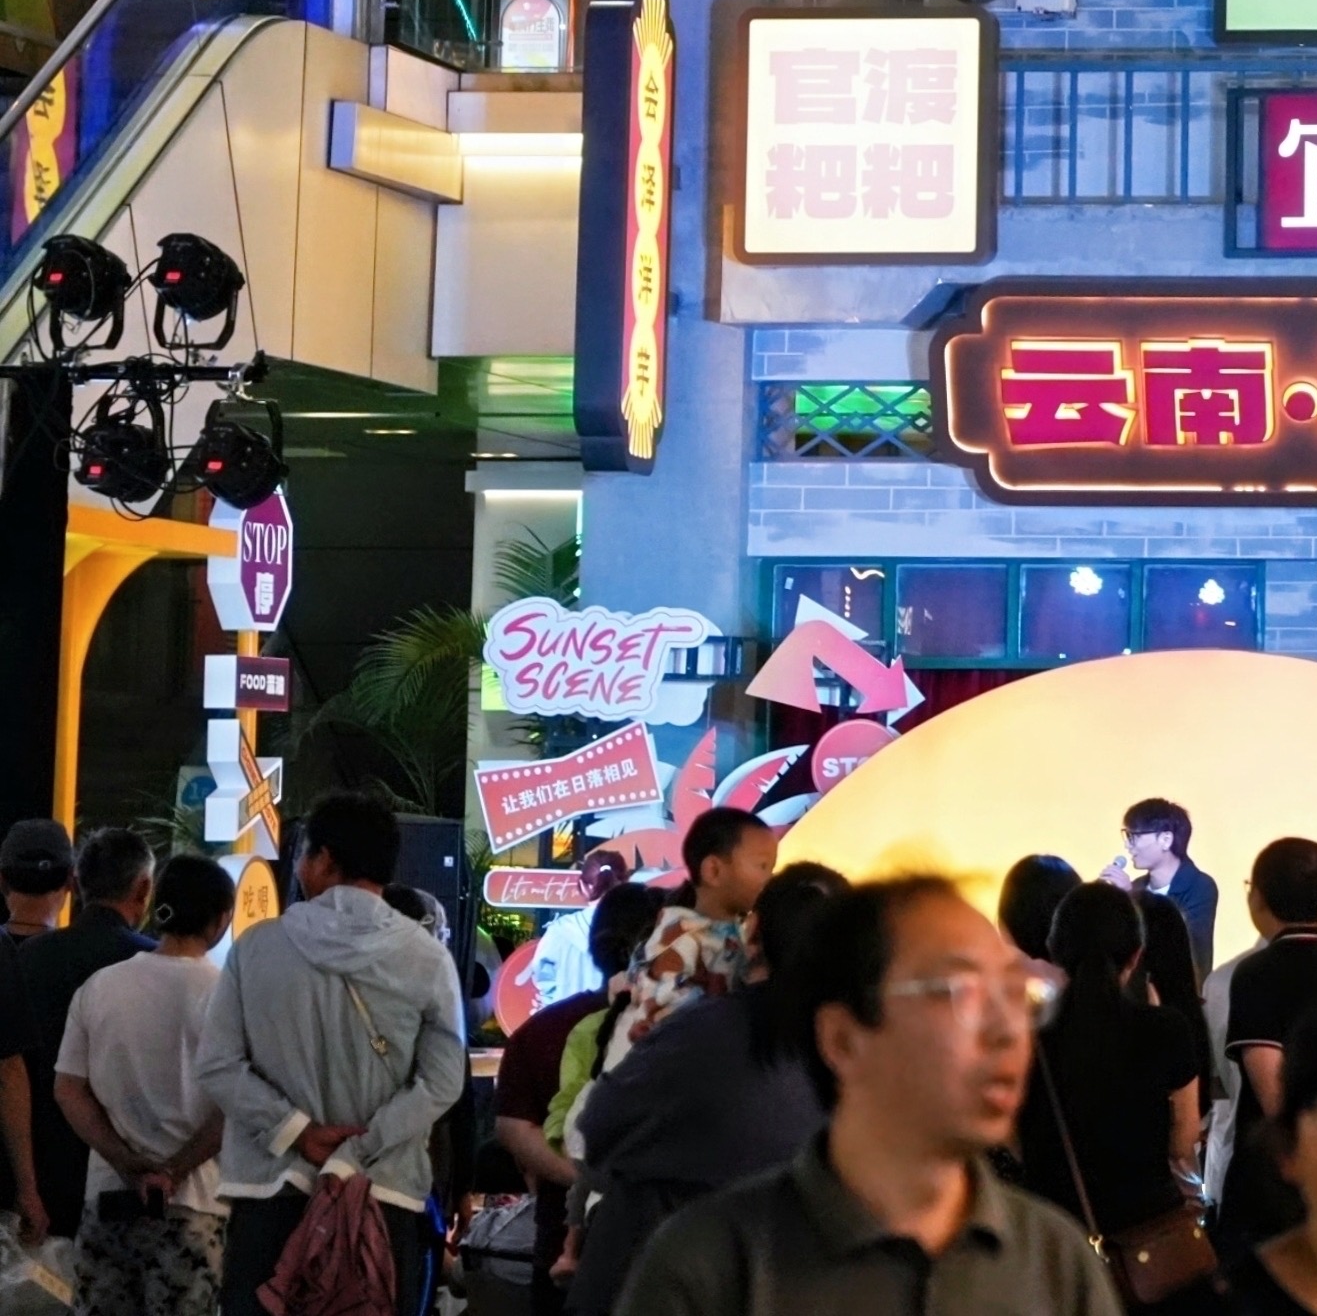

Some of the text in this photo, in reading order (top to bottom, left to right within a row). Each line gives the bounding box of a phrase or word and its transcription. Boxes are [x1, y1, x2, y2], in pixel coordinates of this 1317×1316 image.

[769, 48, 959, 125] 官渡
[765, 143, 956, 221] 粑粑
[243, 522, 288, 565] STOP
[499, 612, 692, 667] SUNSET
[240, 673, 267, 691] FOOD
[515, 660, 645, 706] SCENE
[502, 758, 638, 815] 让我们在日落相见
[822, 756, 869, 778] ST
